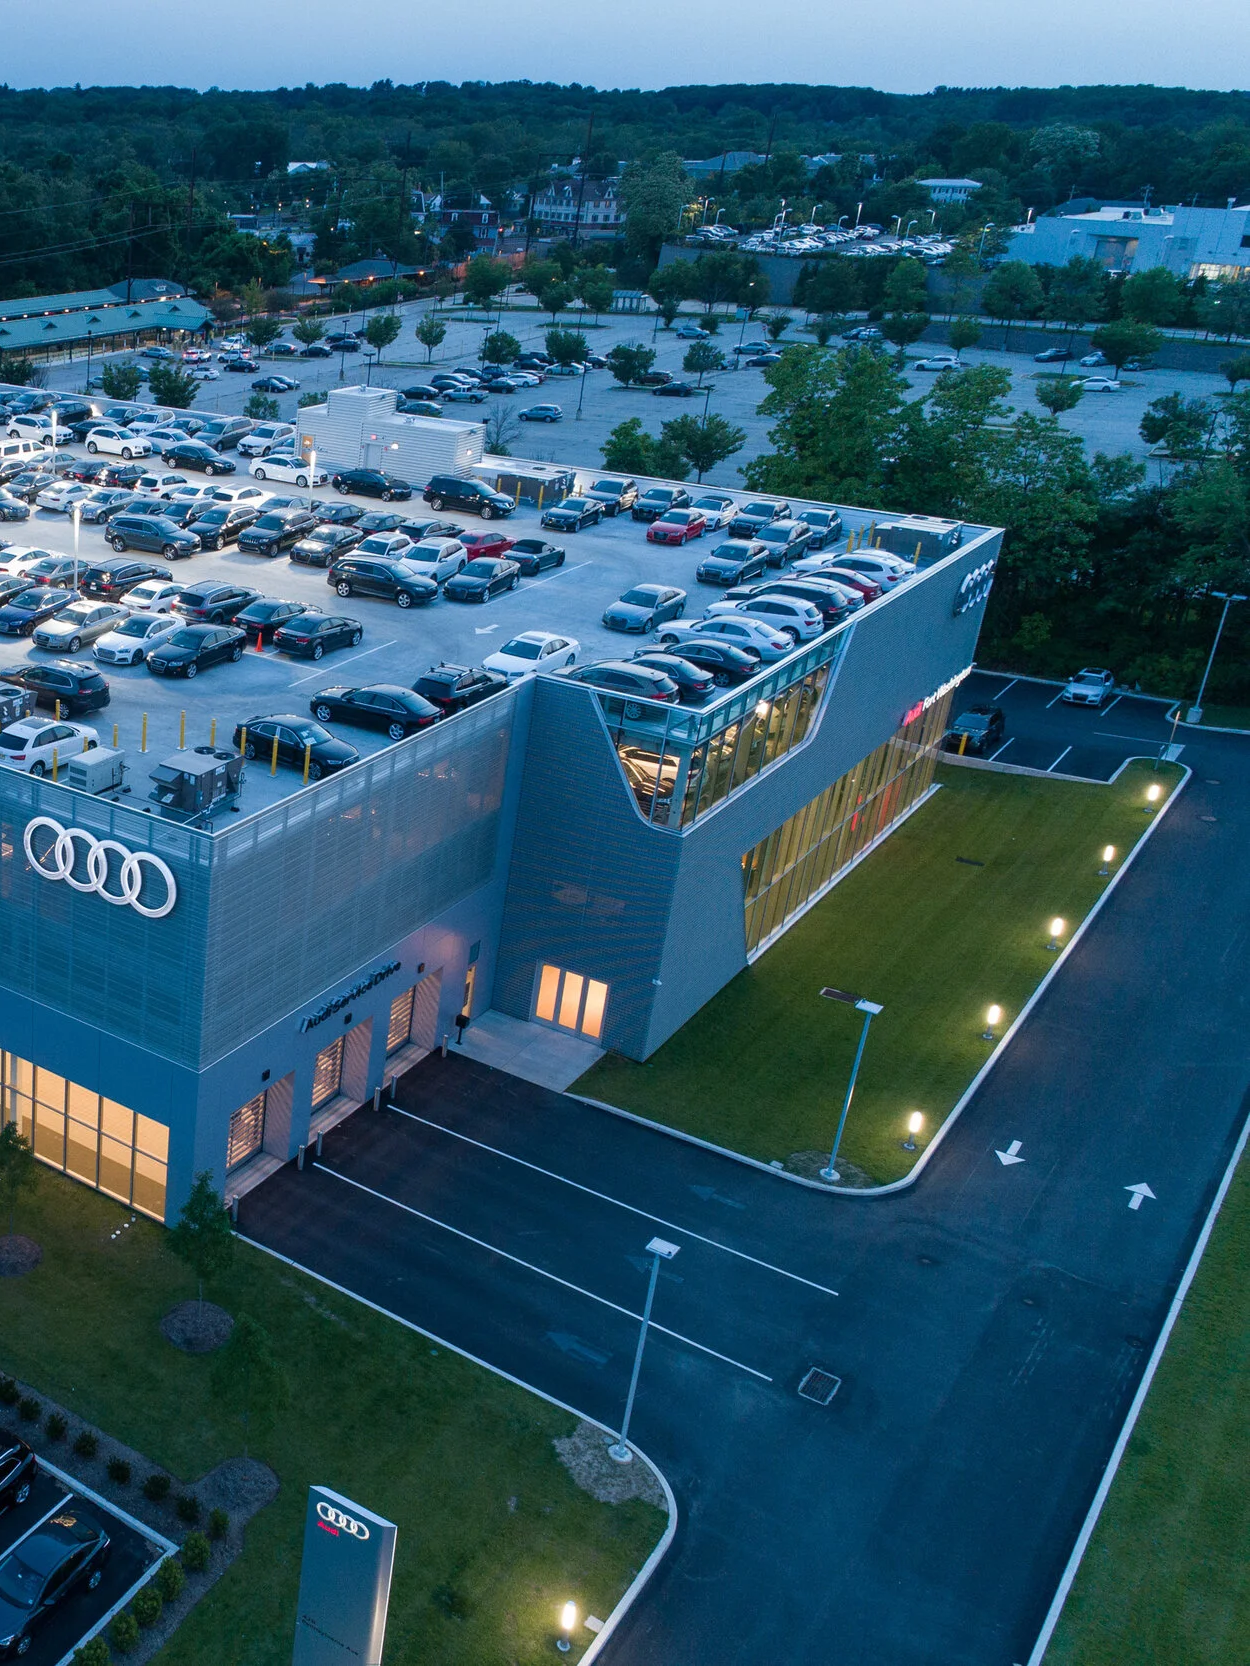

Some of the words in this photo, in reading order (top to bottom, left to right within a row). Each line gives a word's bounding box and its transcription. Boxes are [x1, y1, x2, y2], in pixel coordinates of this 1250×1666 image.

[903, 701, 924, 727] Audi
[922, 692, 937, 711] Fort
[302, 1003, 332, 1033] Audi
[331, 980, 373, 1014] Service
[372, 960, 402, 986] Drive
[317, 1521, 339, 1537] Audi
